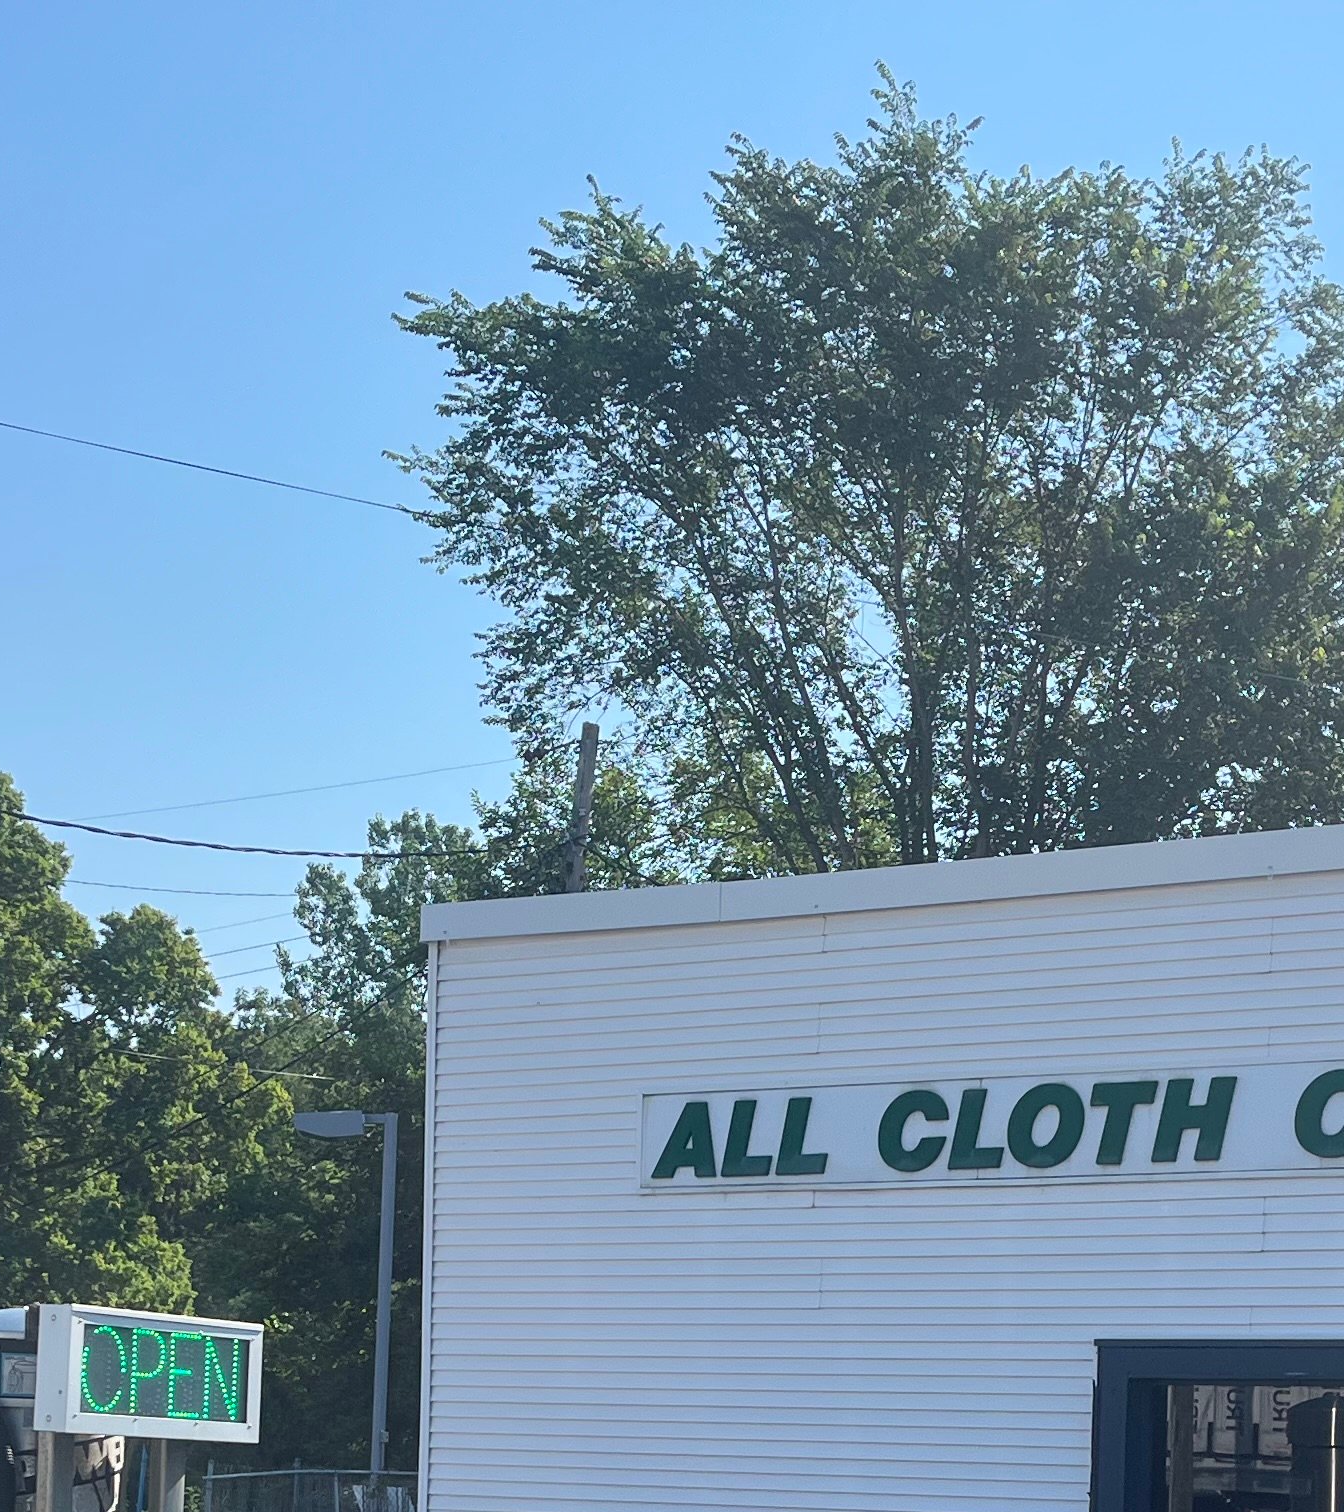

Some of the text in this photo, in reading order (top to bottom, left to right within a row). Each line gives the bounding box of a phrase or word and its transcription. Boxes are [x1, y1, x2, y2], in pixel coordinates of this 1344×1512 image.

[651, 1097, 828, 1179] ALL
[878, 1076, 1238, 1173] CLOTH
[80, 1325, 239, 1421] OPEN
